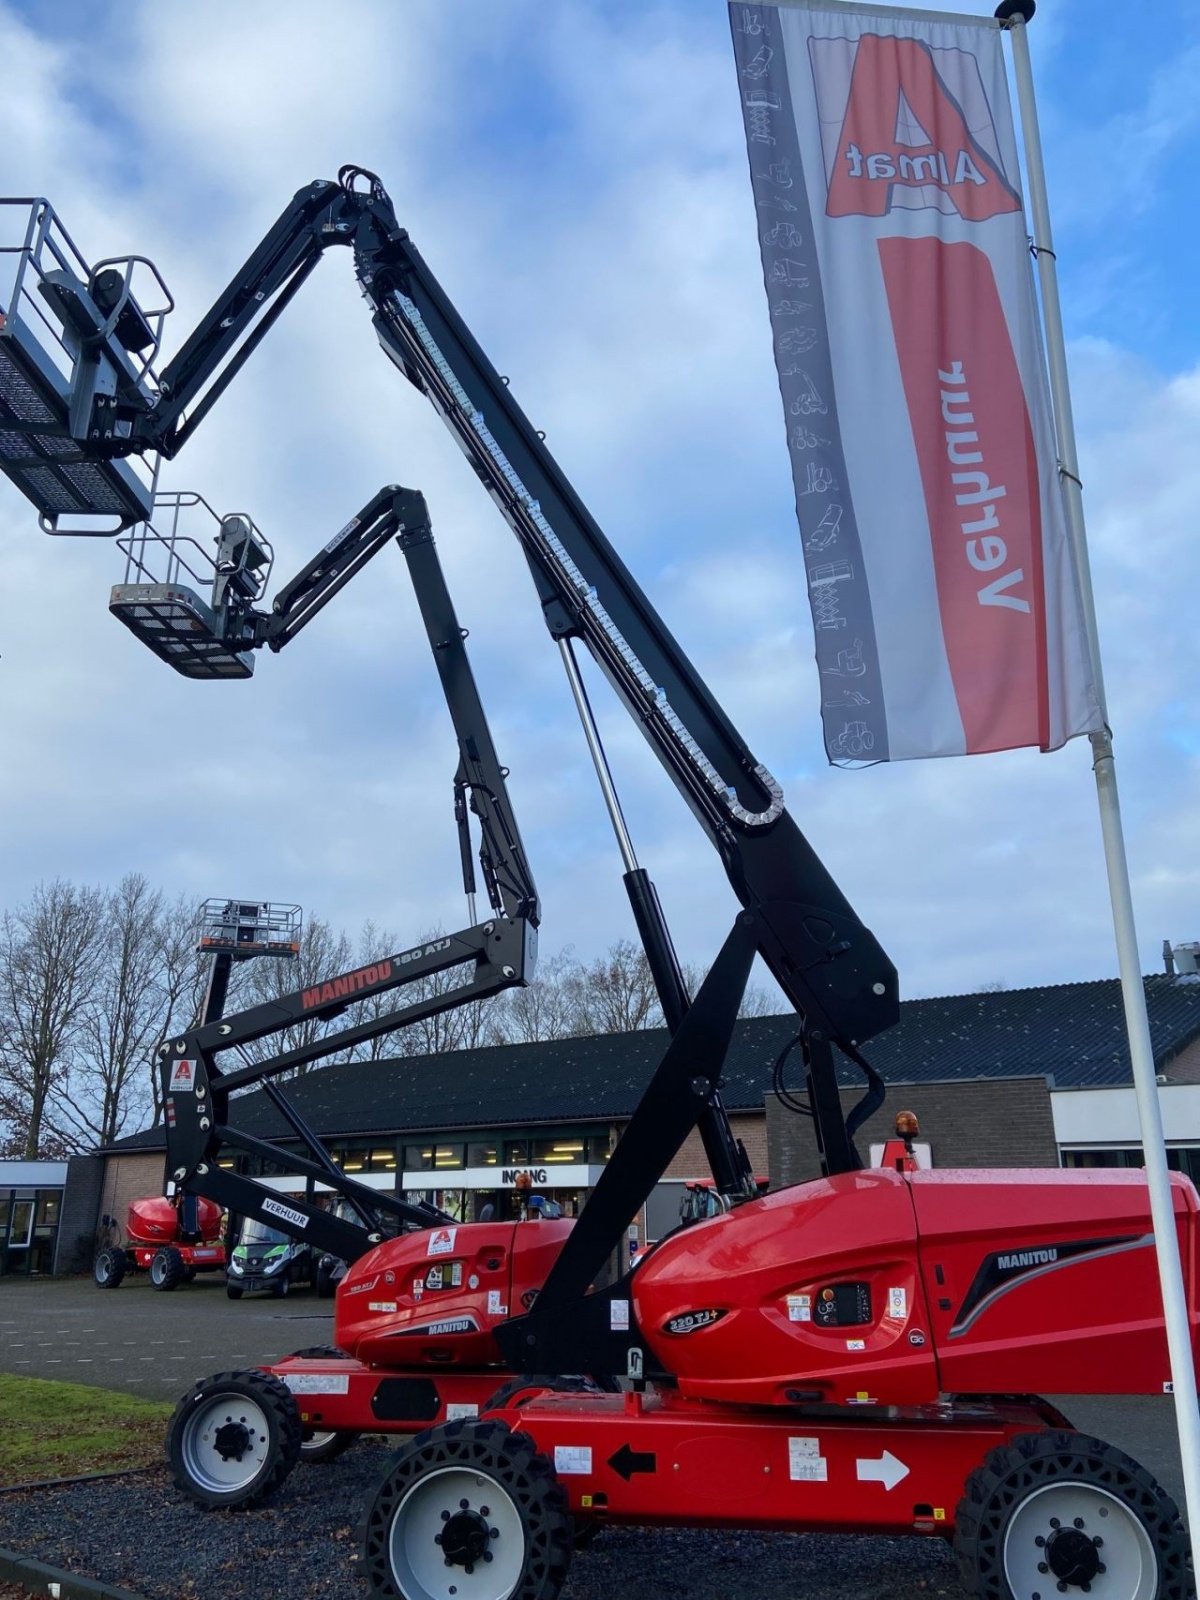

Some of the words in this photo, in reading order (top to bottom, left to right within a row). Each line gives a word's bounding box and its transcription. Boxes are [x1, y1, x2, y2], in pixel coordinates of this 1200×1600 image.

[302, 959, 393, 1009] MANITOU
[393, 949, 422, 966] 180
[425, 939, 451, 956] ATJ
[502, 1168, 547, 1184] INGNG
[265, 1200, 307, 1225] VERHUUR
[997, 1248, 1058, 1269] MANITOU
[428, 1321, 469, 1335] MANITOU
[670, 1316, 694, 1330] 220
